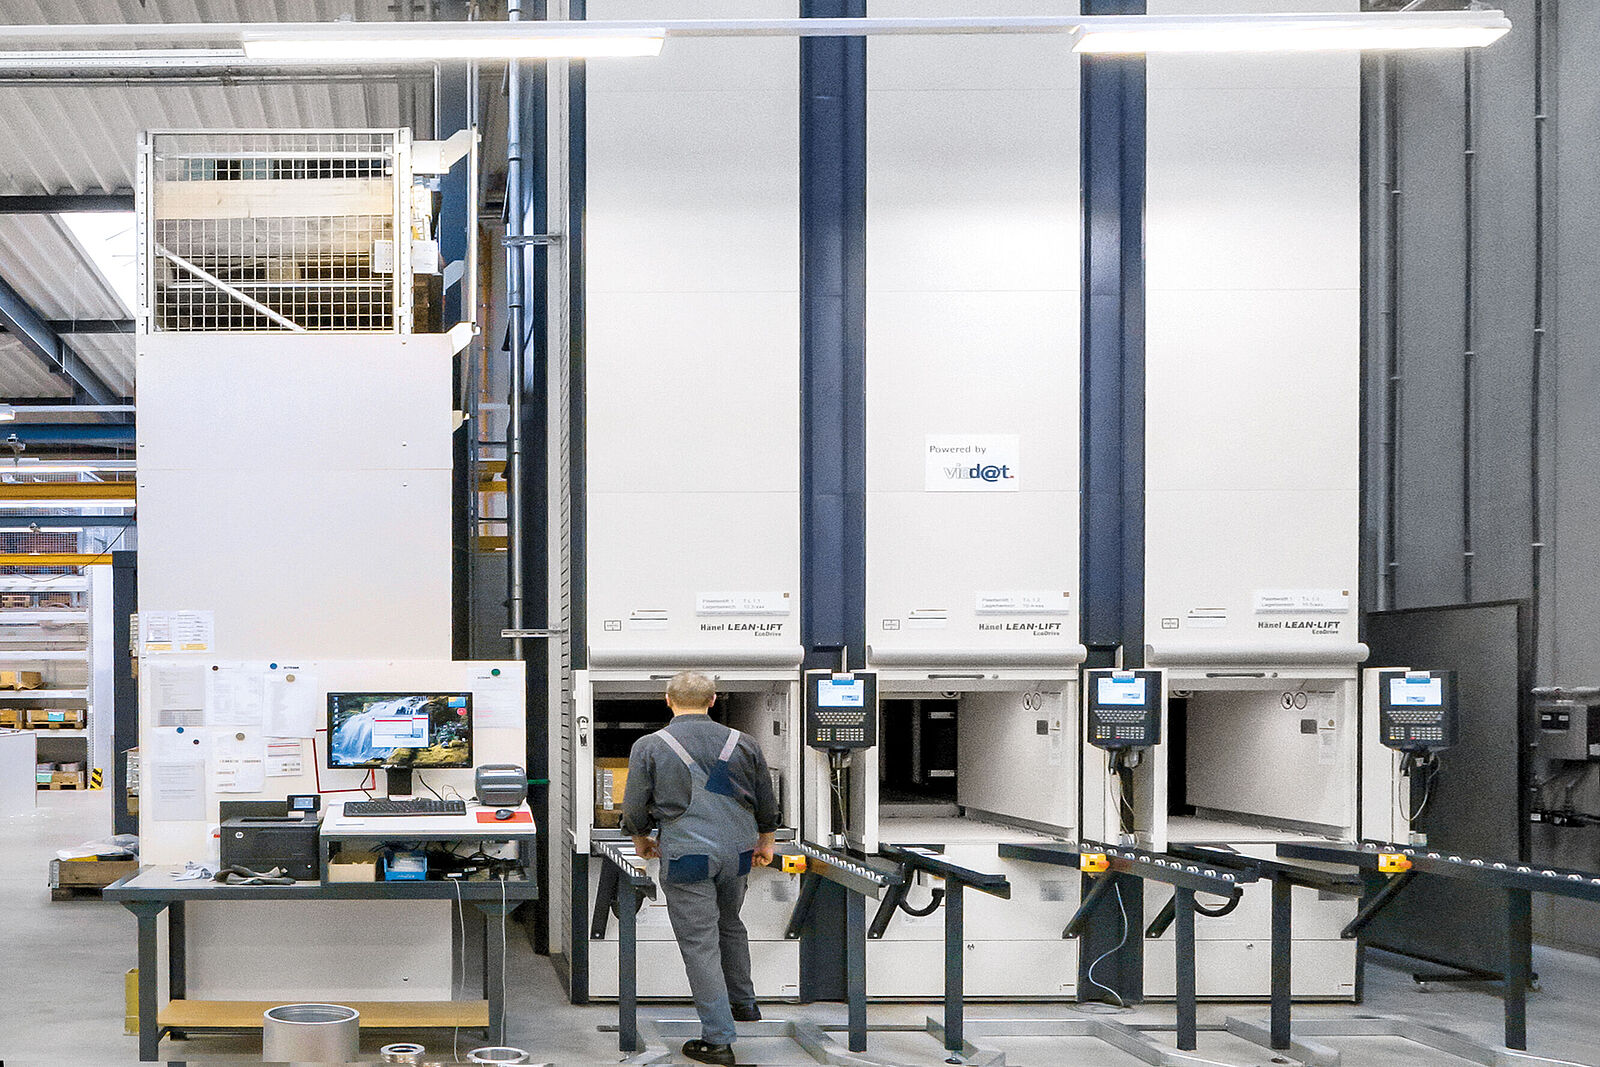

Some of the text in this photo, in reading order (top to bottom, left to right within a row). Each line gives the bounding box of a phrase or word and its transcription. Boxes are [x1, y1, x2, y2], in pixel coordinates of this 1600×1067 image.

[929, 445, 987, 455] Powered by
[700, 623, 725, 631] Hänel
